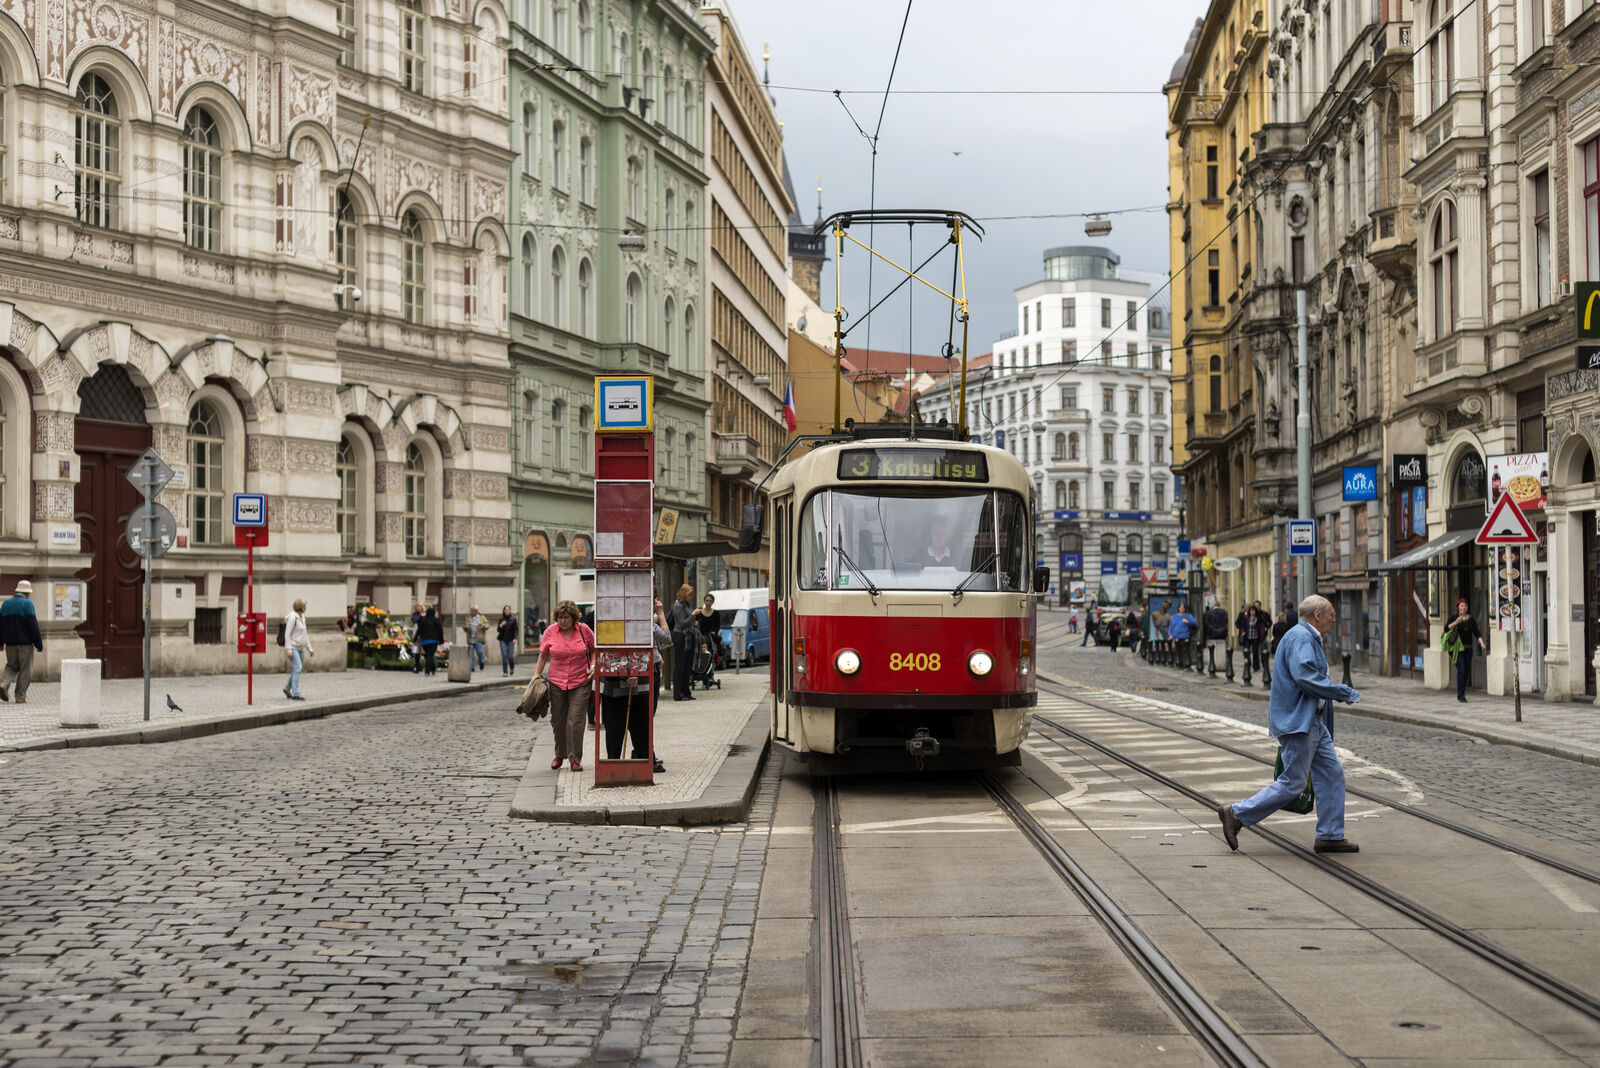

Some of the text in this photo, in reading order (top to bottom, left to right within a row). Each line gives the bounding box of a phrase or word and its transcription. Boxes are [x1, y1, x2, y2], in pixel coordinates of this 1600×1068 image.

[852, 453, 977, 478] 3 Kobylisy
[1399, 460, 1422, 477] PASTA
[1506, 454, 1539, 467] PIZZA
[1345, 480, 1375, 491] AURA
[889, 652, 942, 671] 8408
